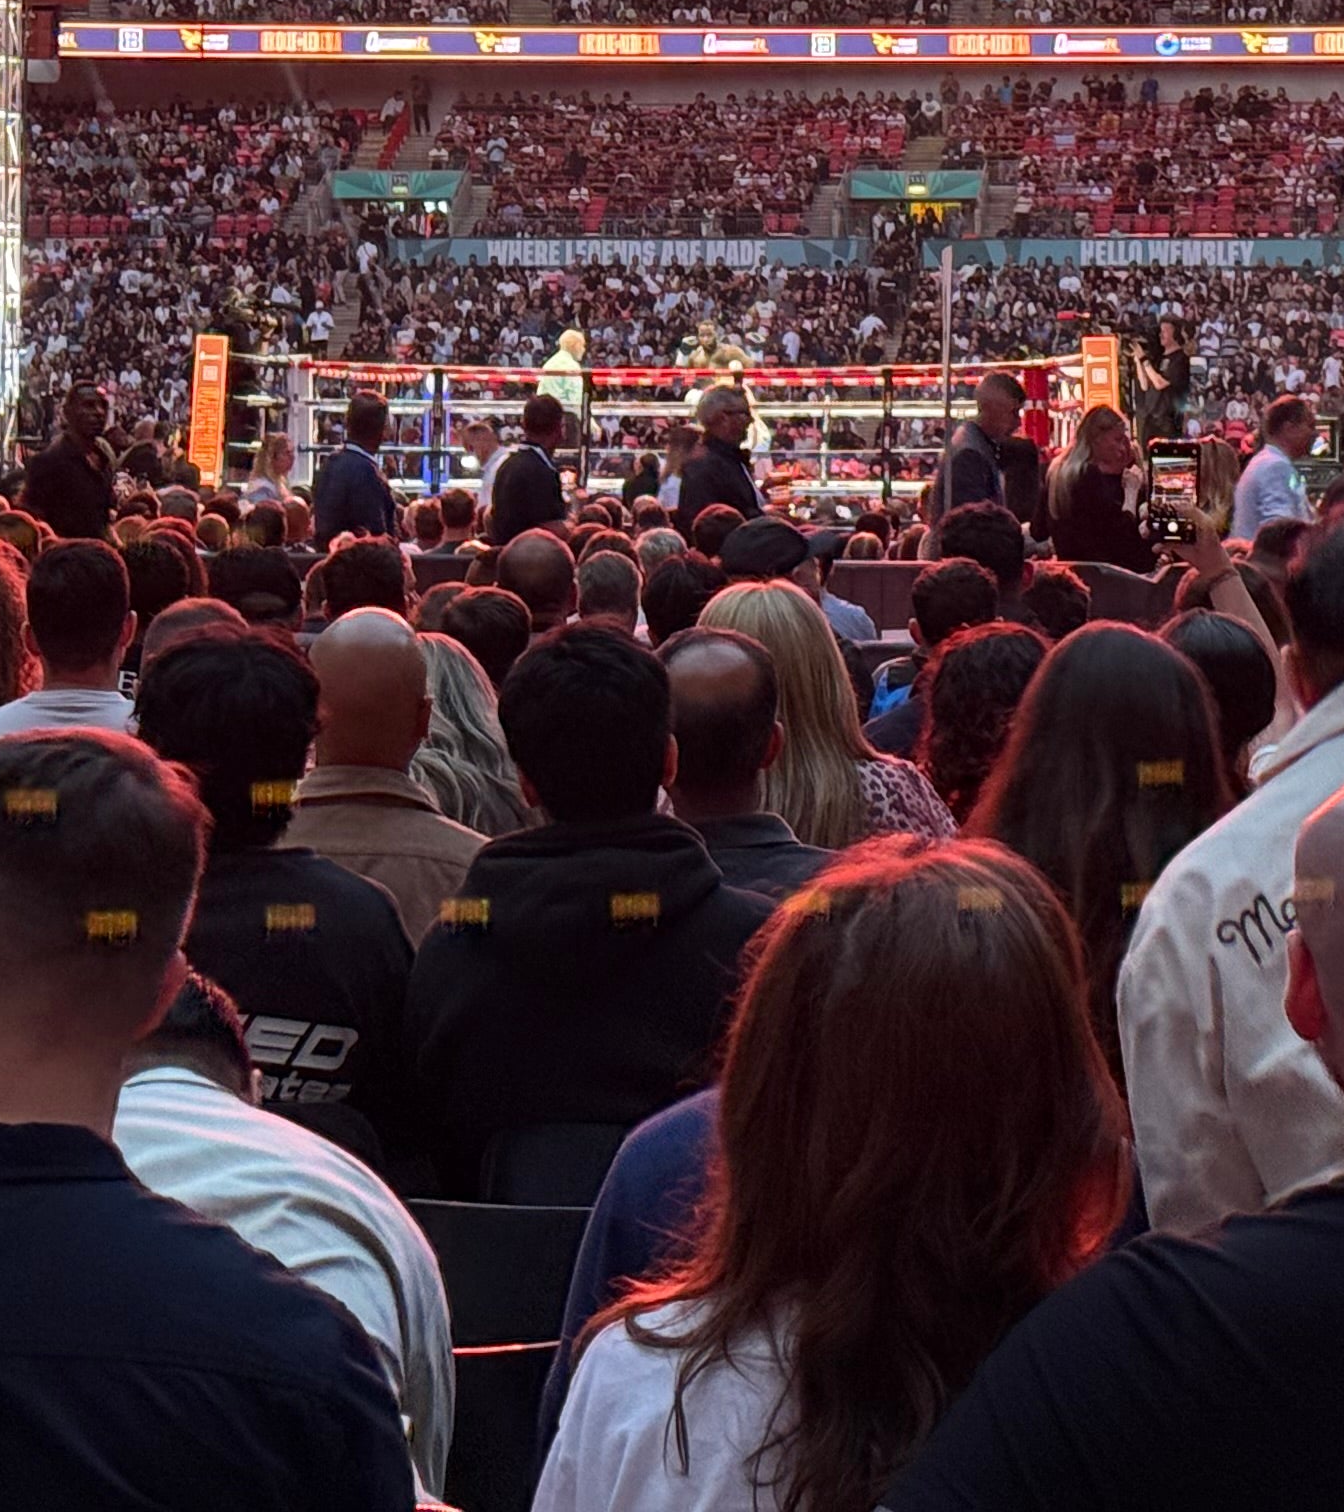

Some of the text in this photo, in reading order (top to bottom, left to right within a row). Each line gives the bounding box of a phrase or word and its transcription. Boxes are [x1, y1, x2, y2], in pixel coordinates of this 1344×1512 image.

[487, 240, 766, 266] WHERE LEGENDS ARE MADE
[1080, 240, 1255, 266] HELLO WEMBLEY
